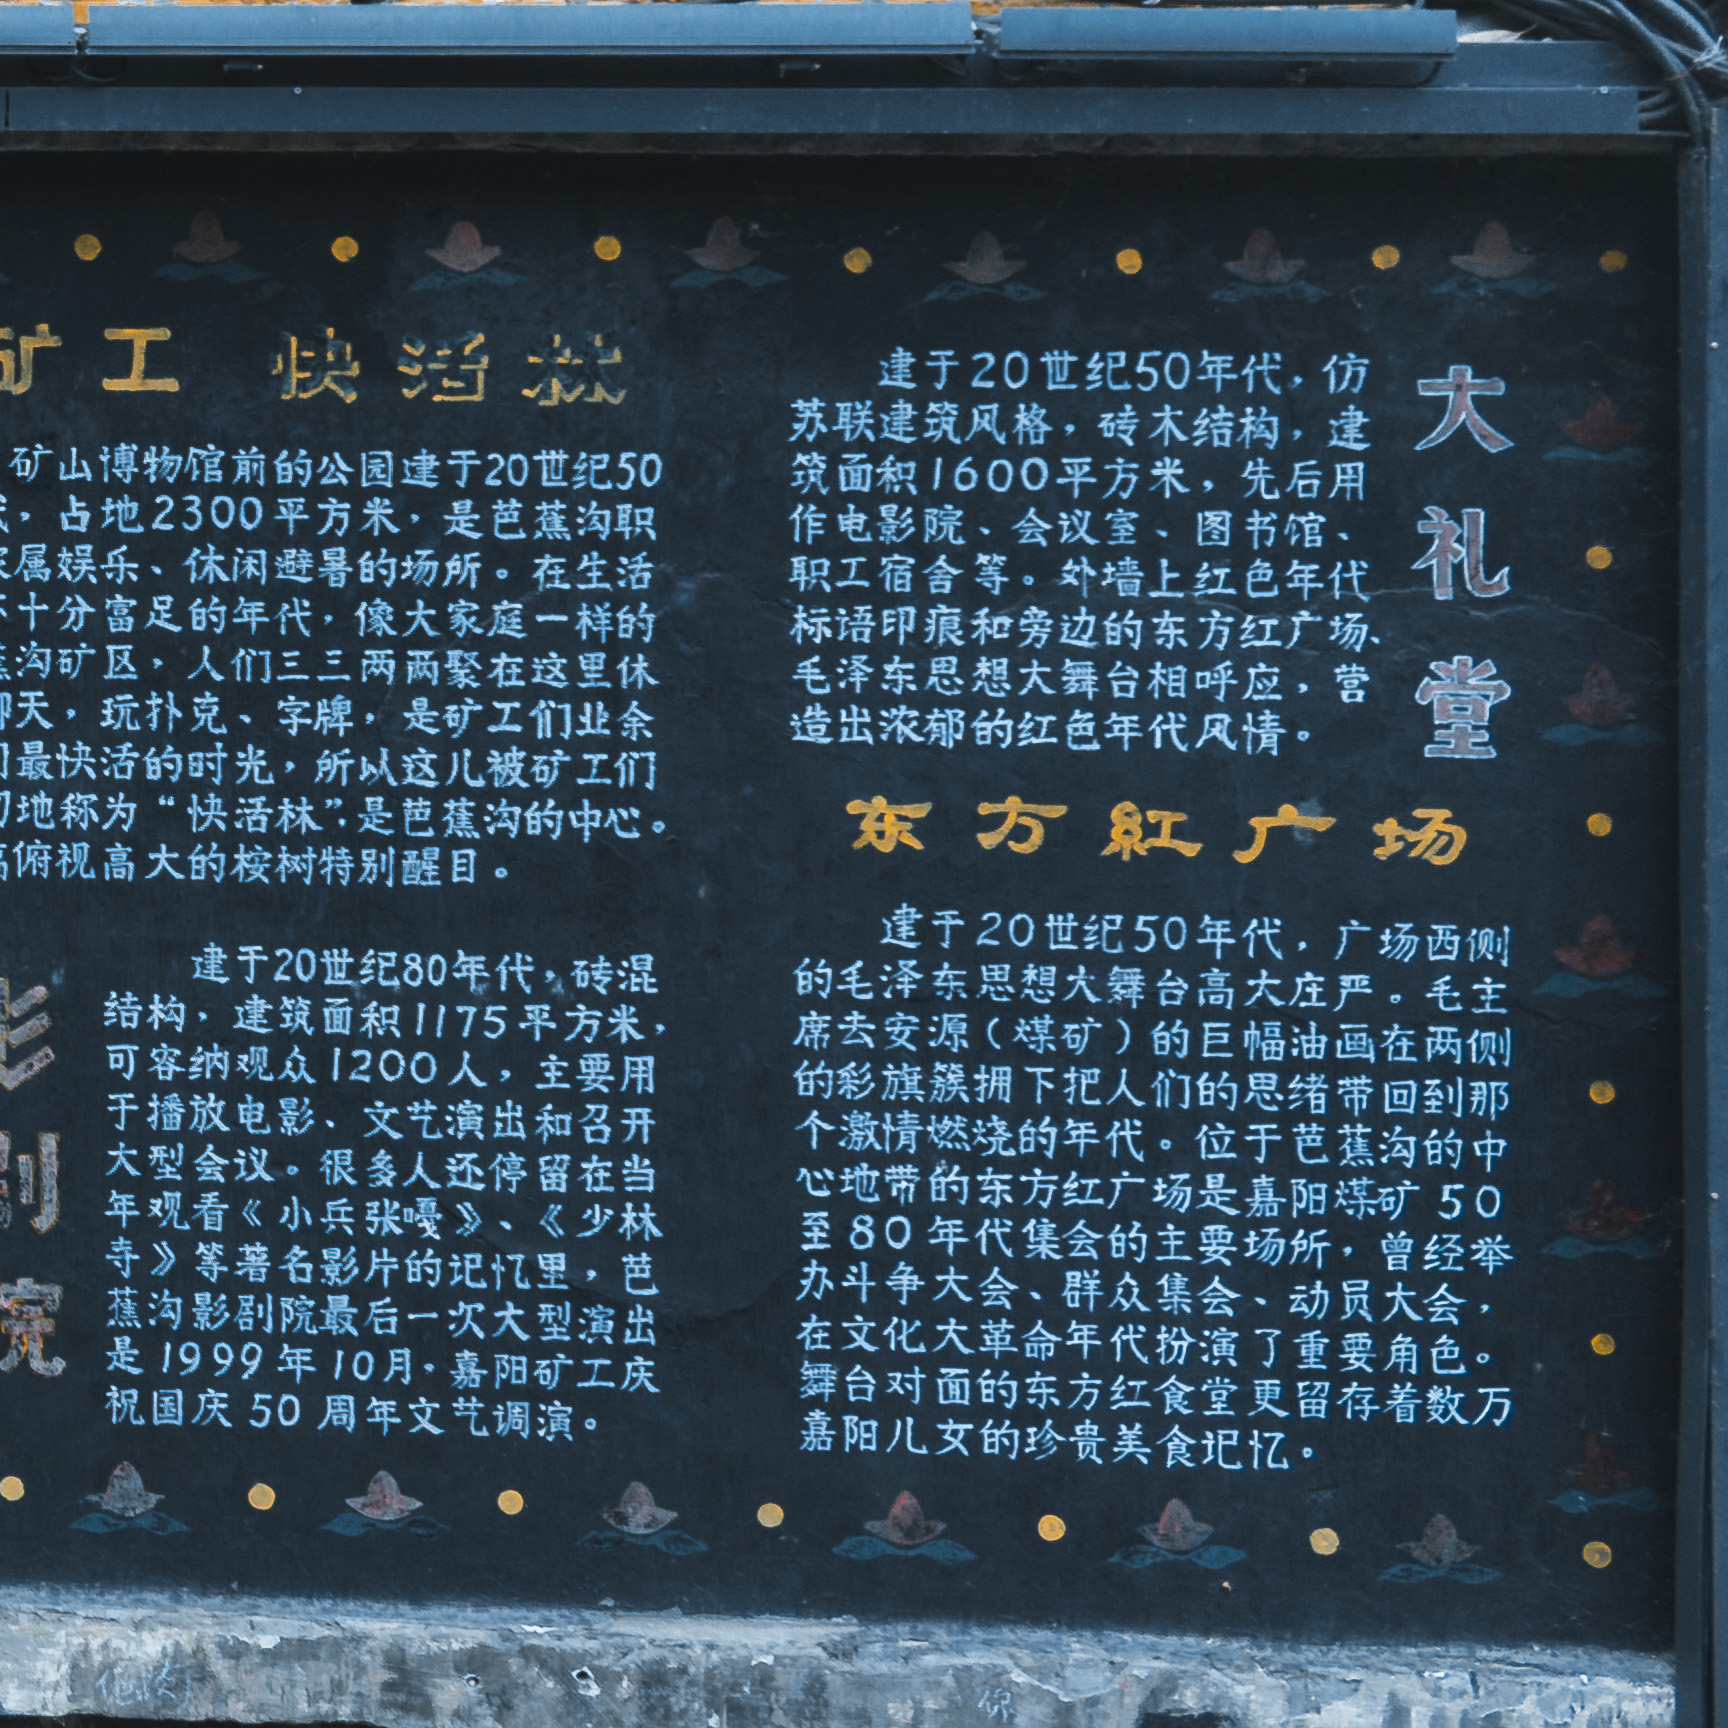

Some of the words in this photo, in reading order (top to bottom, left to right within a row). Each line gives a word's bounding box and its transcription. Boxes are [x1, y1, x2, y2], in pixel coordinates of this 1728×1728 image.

[1411, 364, 1514, 759] 大礼堂
[107, 1286, 656, 1346] 蕉沟影剧院最后一次大型演出
